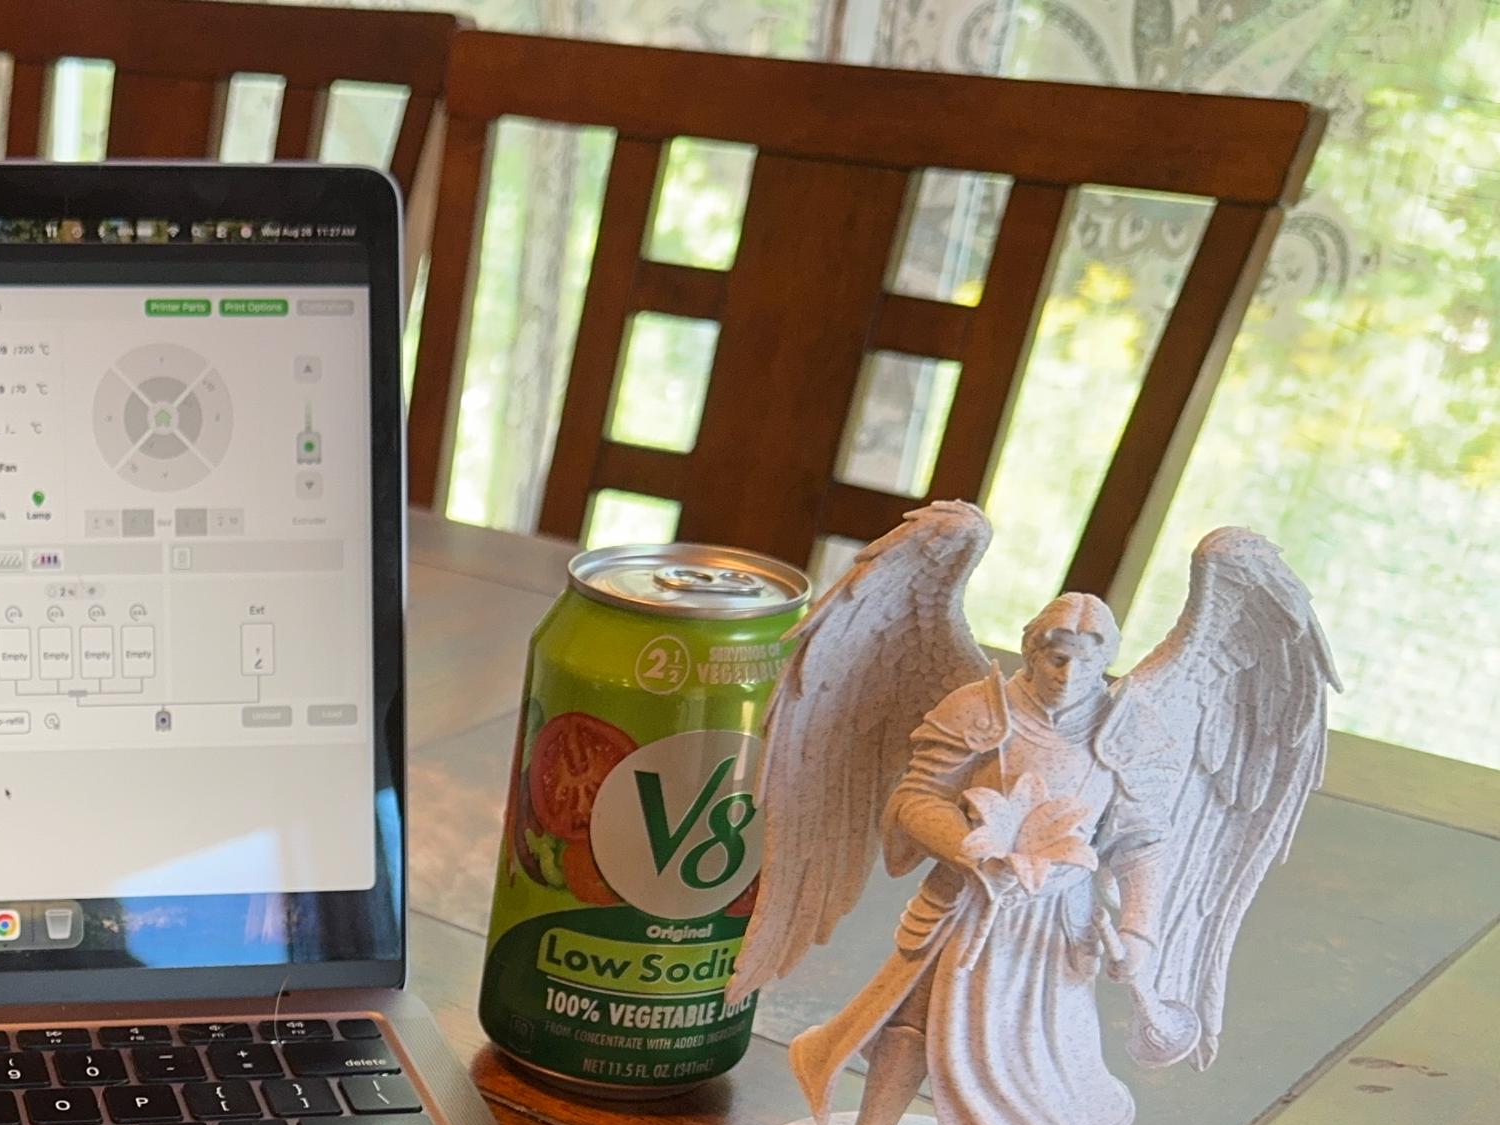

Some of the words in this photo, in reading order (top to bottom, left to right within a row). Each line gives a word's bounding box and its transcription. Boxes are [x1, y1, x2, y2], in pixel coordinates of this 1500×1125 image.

[282, 224, 299, 239] Aug
[151, 303, 180, 312] Printer
[224, 303, 245, 312] Print
[247, 303, 282, 314] Options
[26, 512, 51, 521] Lamp
[249, 605, 265, 615] Ext
[2, 652, 28, 662] Empty
[43, 651, 69, 661] Empty
[84, 651, 111, 661] Empty
[125, 650, 152, 660] Empty
[634, 755, 757, 889] V8
[646, 923, 714, 943] Original
[545, 934, 632, 979] Low
[638, 947, 737, 984] Sodi
[546, 987, 601, 1022] 100%
[609, 1001, 717, 1029] VEGETABLE
[574, 1029, 644, 1050] CONCENTRATE
[646, 1039, 671, 1050] WITH
[673, 1034, 705, 1049] ADDED
[345, 1058, 387, 1067] delete
[86, 1067, 99, 1076] 0
[583, 1058, 606, 1073] NET
[608, 1062, 634, 1078] 11.5
[8, 1070, 20, 1079] 9
[56, 1101, 70, 1110] O
[136, 1098, 148, 1107] P
